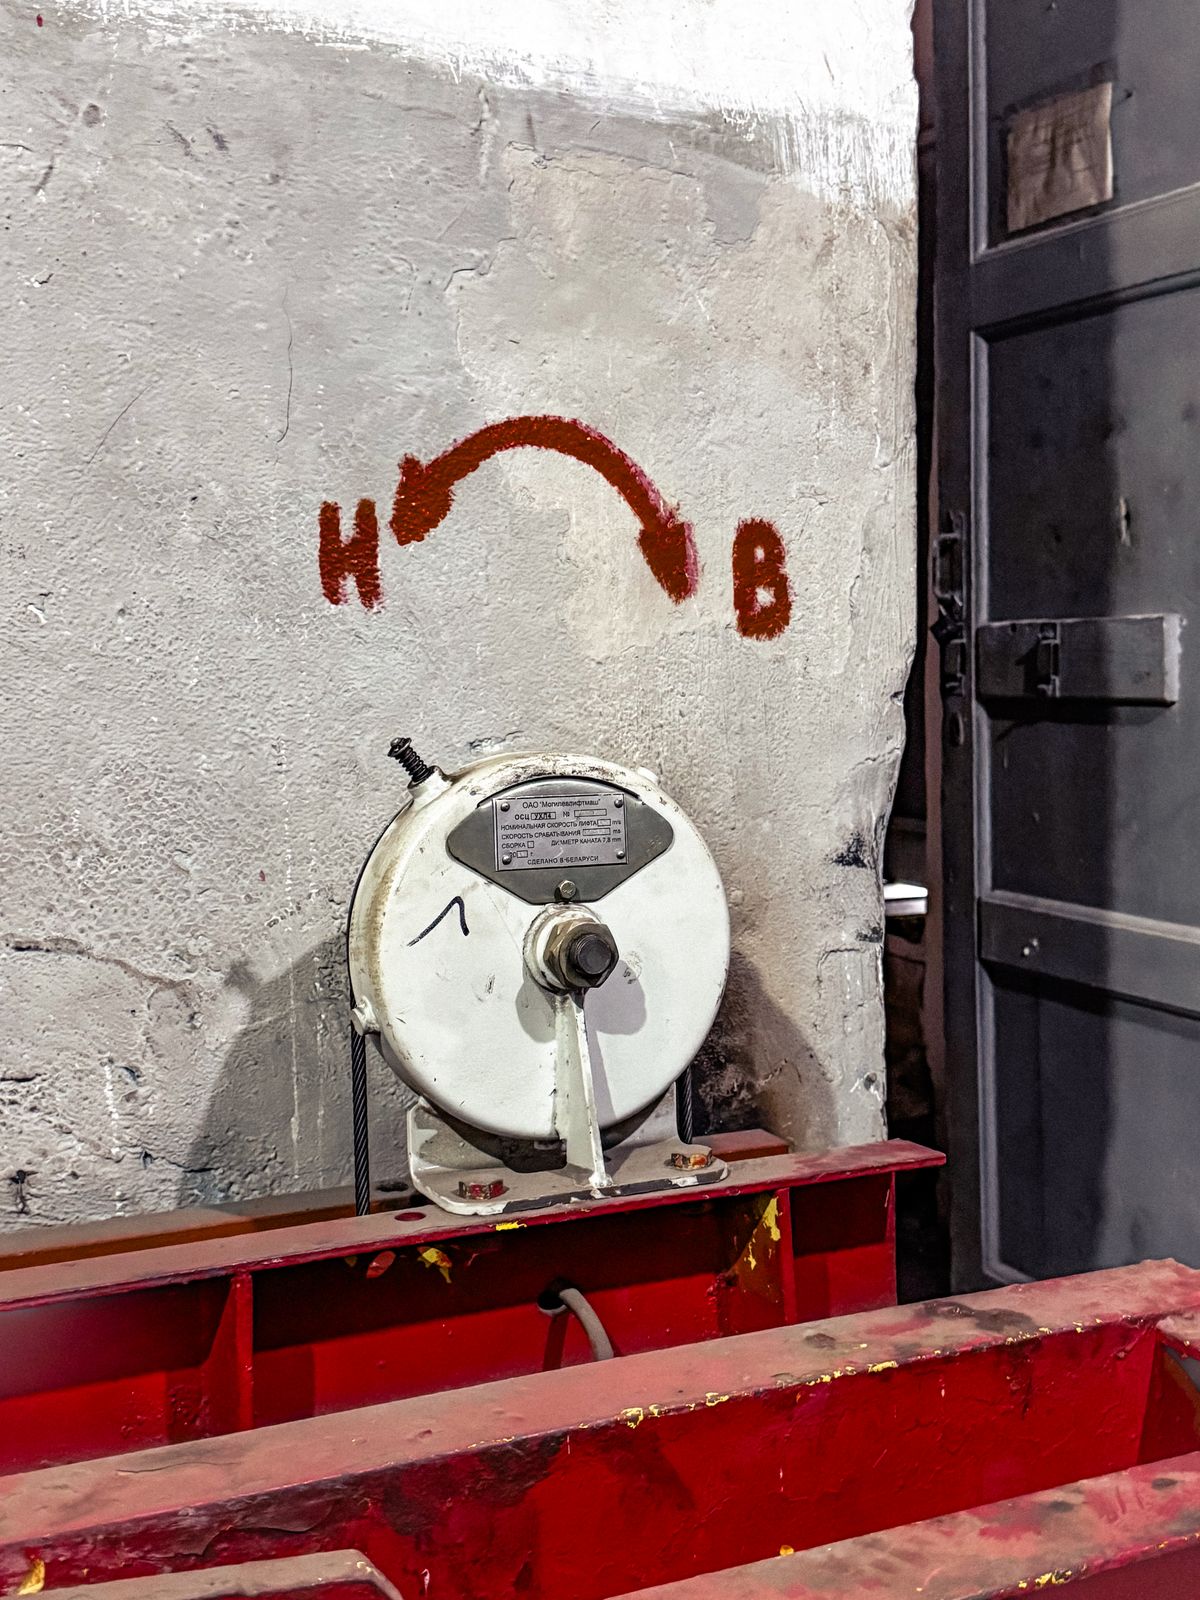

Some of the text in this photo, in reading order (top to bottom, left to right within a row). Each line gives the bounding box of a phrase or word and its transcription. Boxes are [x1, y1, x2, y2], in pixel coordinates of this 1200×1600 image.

[522, 801, 539, 809] ОАО
[501, 822, 546, 831] НОМИНАЛЬНАЯ
[546, 821, 578, 829] СКОРОСТЬ
[501, 832, 533, 840] СКОРОСТЬ
[534, 830, 581, 839] СРАБАТЫВАНИЯ
[527, 857, 558, 866] СДЕЛАНО
